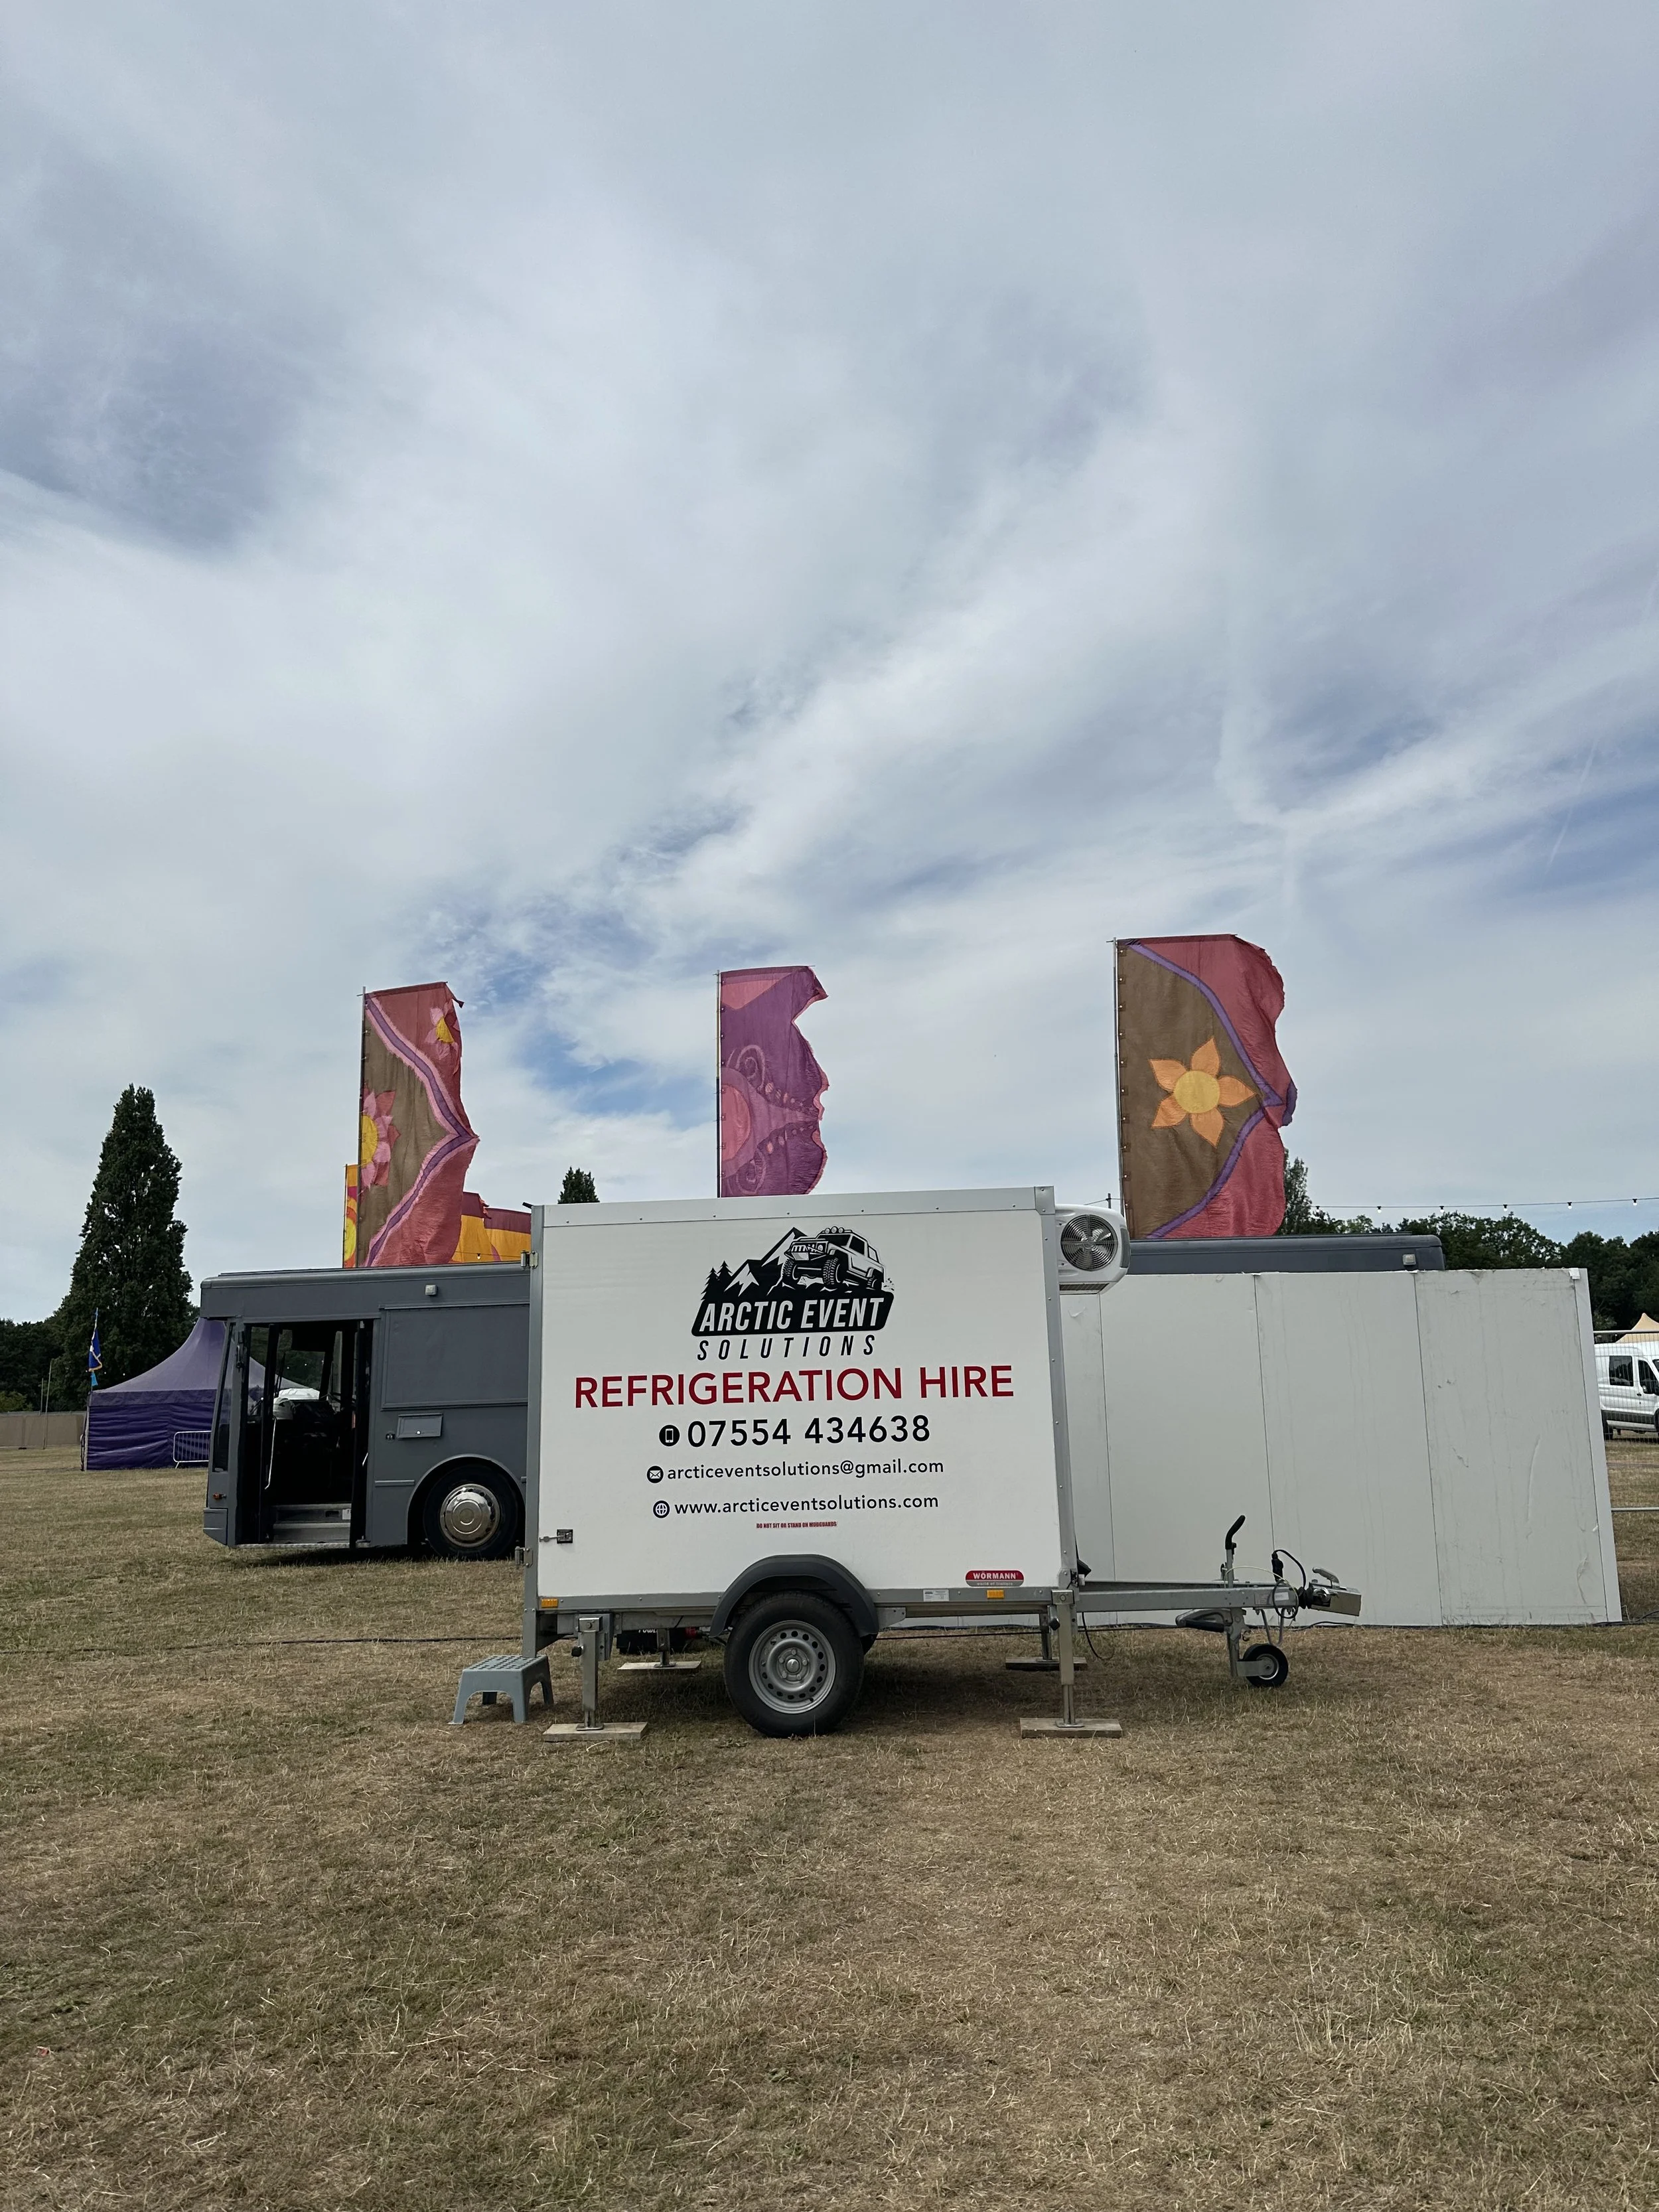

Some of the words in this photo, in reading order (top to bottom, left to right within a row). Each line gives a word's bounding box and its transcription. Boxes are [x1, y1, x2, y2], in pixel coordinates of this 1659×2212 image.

[699, 1301, 793, 1332] ARCTIC
[800, 1297, 885, 1329] EVENT
[697, 1334, 875, 1361] SOLUTIONS
[575, 1367, 902, 1408] REFRIGERATION
[920, 1365, 1014, 1398] HIRE
[687, 1418, 791, 1447] 07554
[804, 1414, 930, 1444] 434638
[667, 1458, 944, 1479] arcticeventsolutions@gmail.com
[674, 1494, 938, 1514] www.arcticeventsolutions.com
